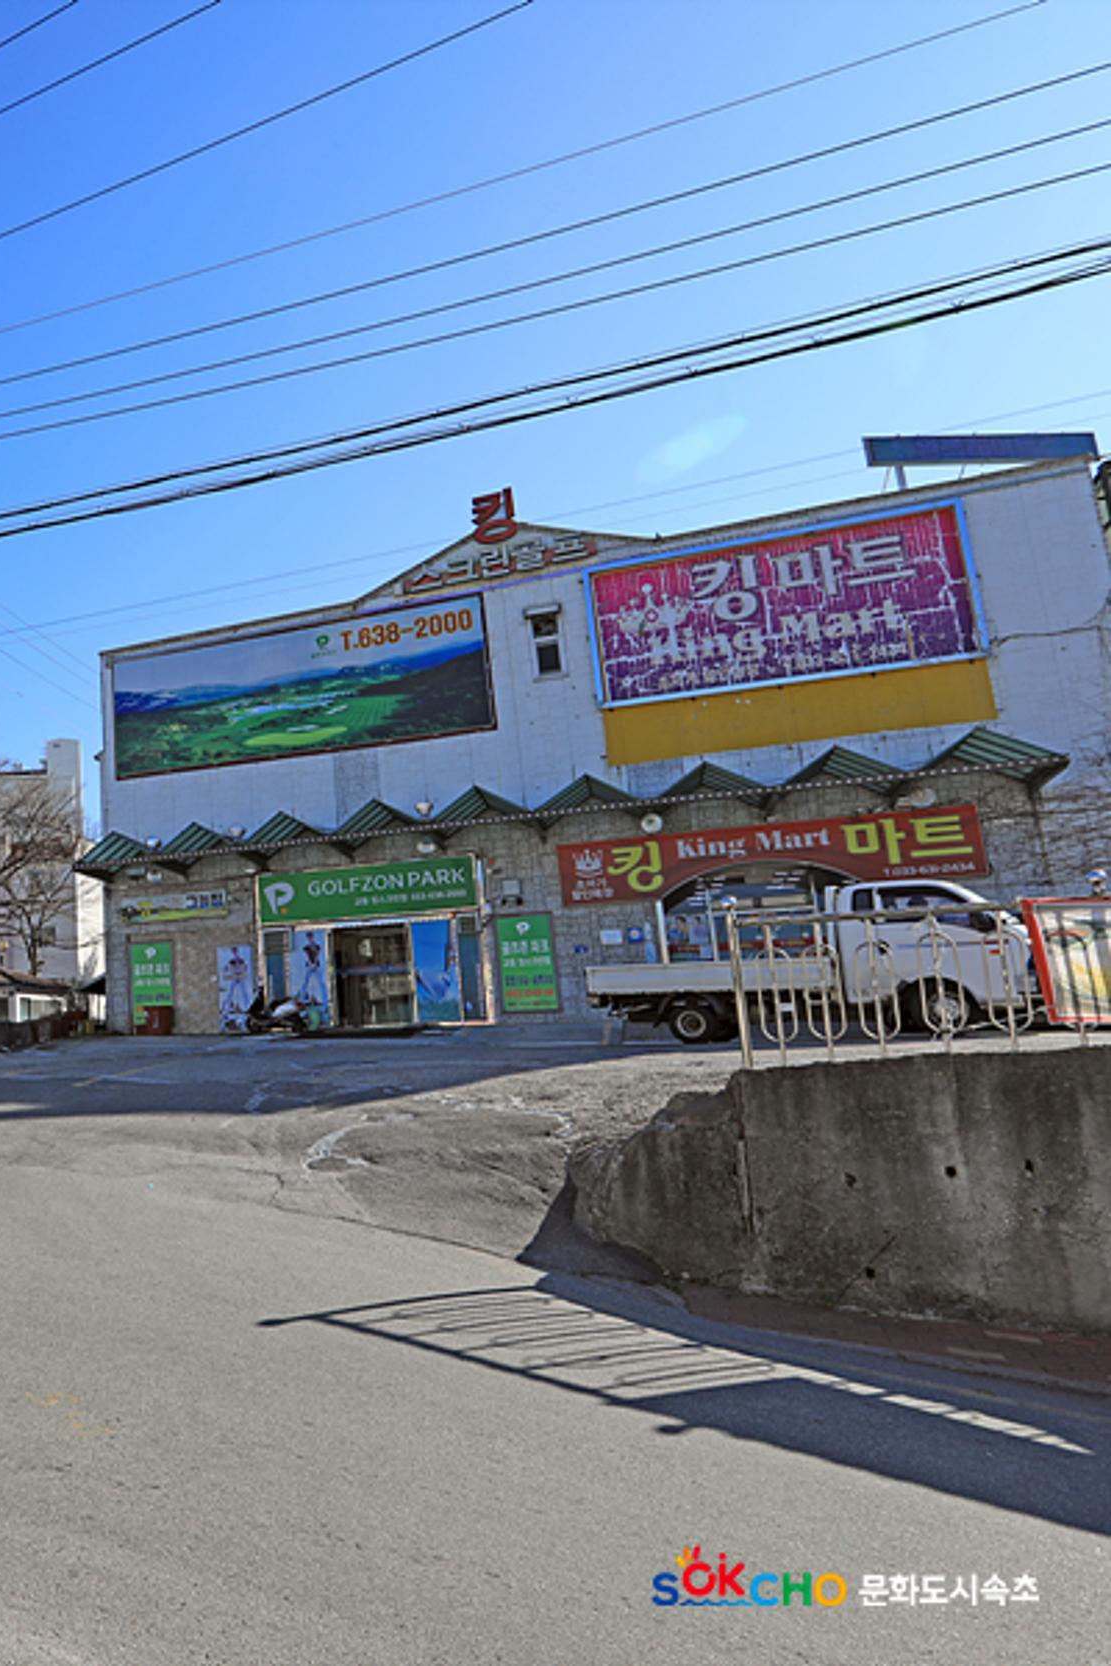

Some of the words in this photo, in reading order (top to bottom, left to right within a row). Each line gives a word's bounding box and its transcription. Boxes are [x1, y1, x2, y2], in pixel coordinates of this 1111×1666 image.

[471, 486, 519, 545] 킹
[404, 534, 593, 593] 스크린골프
[692, 533, 917, 623] 킹마트
[340, 608, 474, 651] T.638-2000
[676, 837, 747, 860] King
[755, 827, 832, 851] Mart
[841, 815, 974, 865] 마트
[307, 872, 405, 897] GOLFZON
[407, 866, 467, 888] PARK
[606, 840, 666, 893] 킹
